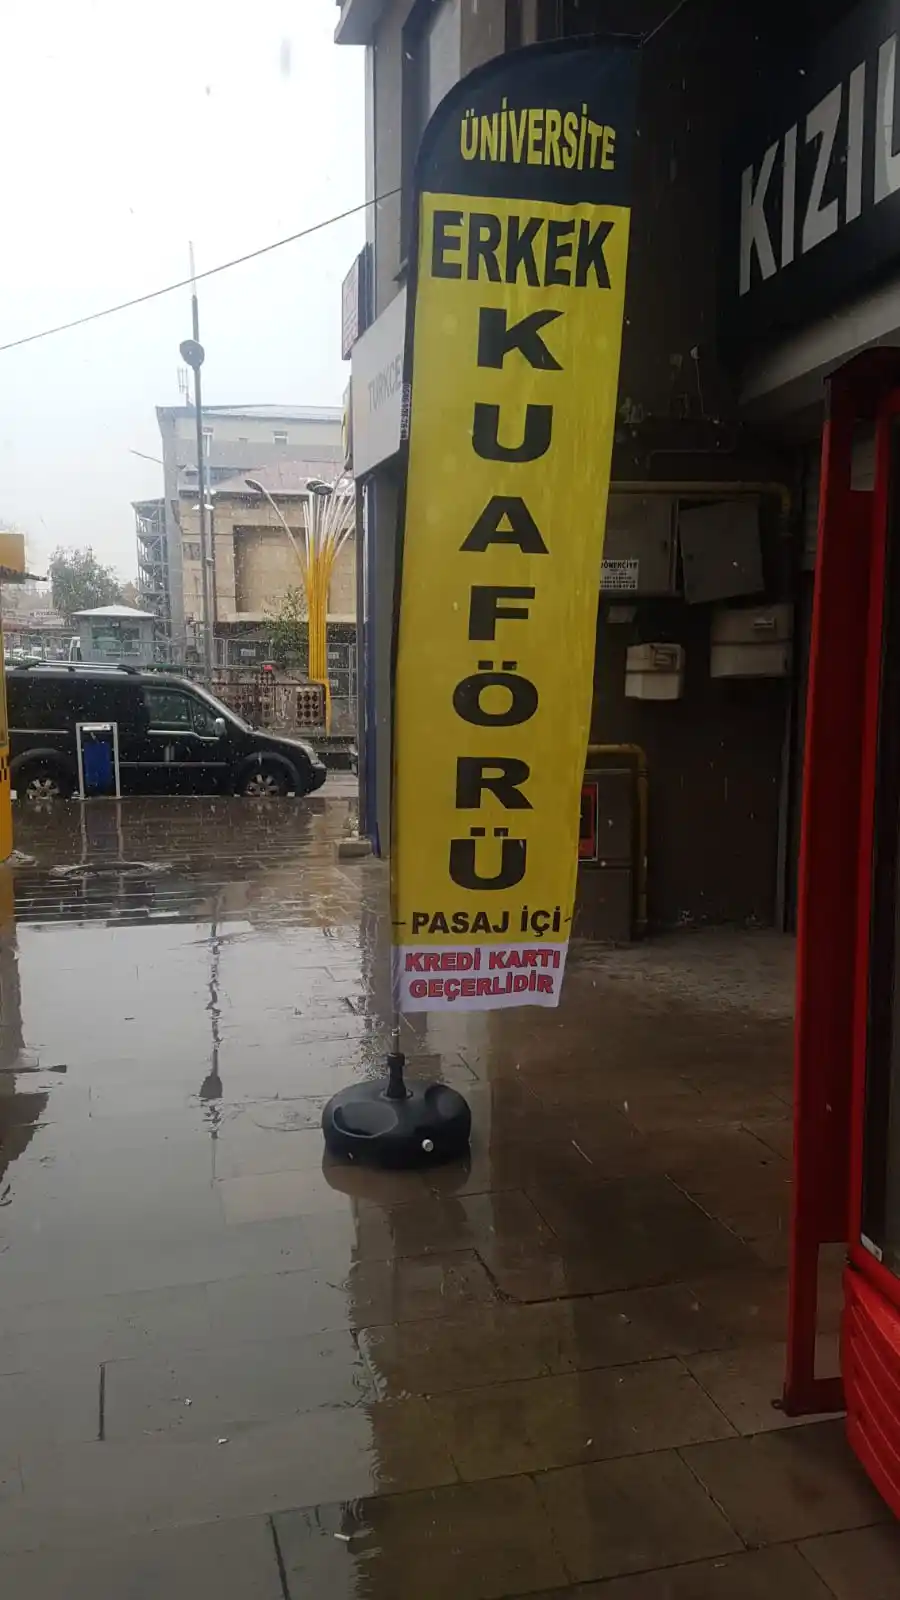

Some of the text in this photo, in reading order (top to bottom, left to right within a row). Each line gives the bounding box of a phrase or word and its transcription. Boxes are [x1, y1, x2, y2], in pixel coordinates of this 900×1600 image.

[460, 97, 616, 170] ÜNİVERSİTE
[431, 210, 615, 289] ERKEK
[449, 306, 565, 891] KUAFÖRÜ
[411, 905, 561, 937] PASAJ İÇİ
[405, 948, 561, 972] KREDİ KARTI
[409, 970, 554, 1001] GEÇERLİDİR
